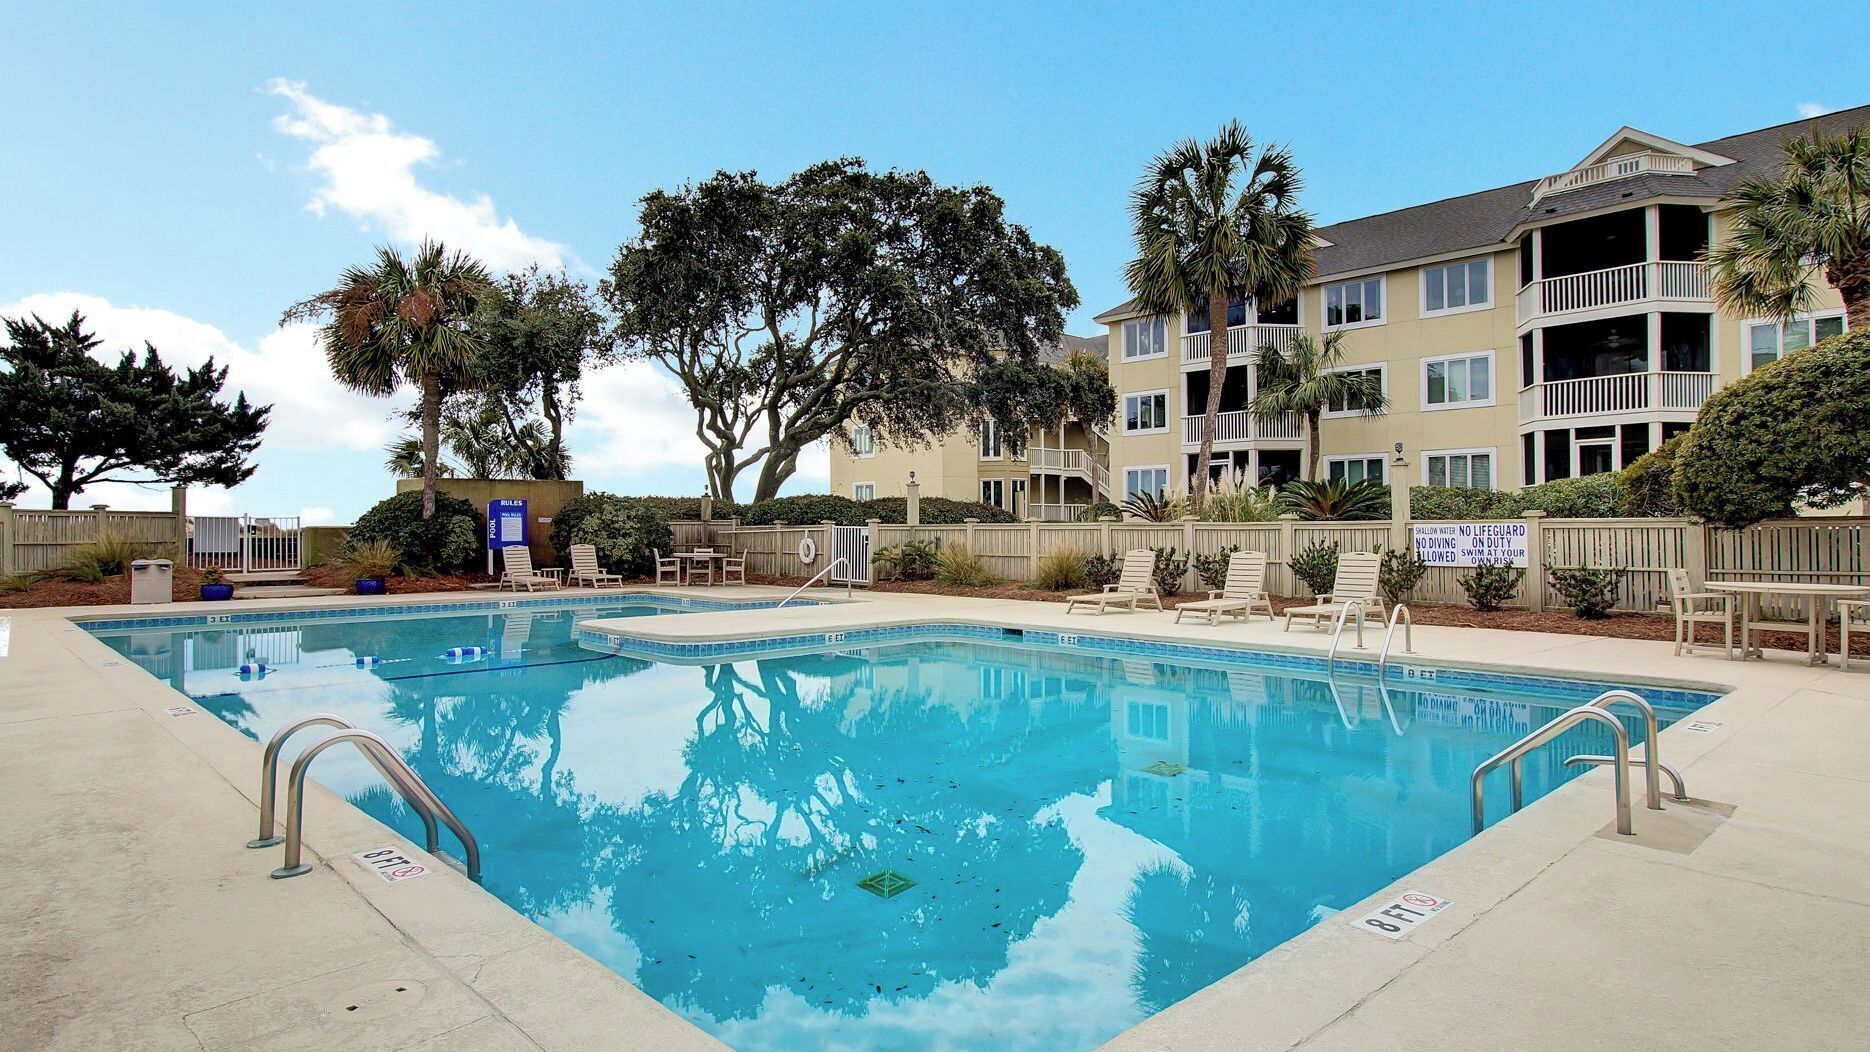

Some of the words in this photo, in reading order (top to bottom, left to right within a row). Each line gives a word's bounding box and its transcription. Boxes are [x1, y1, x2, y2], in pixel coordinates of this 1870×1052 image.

[1415, 527, 1438, 535] SHALLOW
[1440, 527, 1456, 535] WATER
[1459, 525, 1471, 537] NO
[1474, 525, 1525, 537] LIFEGUARD
[1416, 538, 1427, 549] NO
[1429, 538, 1456, 549] DIVING
[1472, 537, 1484, 549] ON
[1487, 537, 1512, 549] DUTY
[1461, 549, 1485, 557] SWIM
[1488, 549, 1498, 557] AT
[1501, 549, 1525, 557] YOUR
[1471, 557, 1491, 565] OWN
[1494, 557, 1514, 565] RISK
[363, 849, 394, 858] 8
[371, 856, 411, 869] FT
[1380, 904, 1425, 923] FT
[1365, 919, 1401, 932] 8
